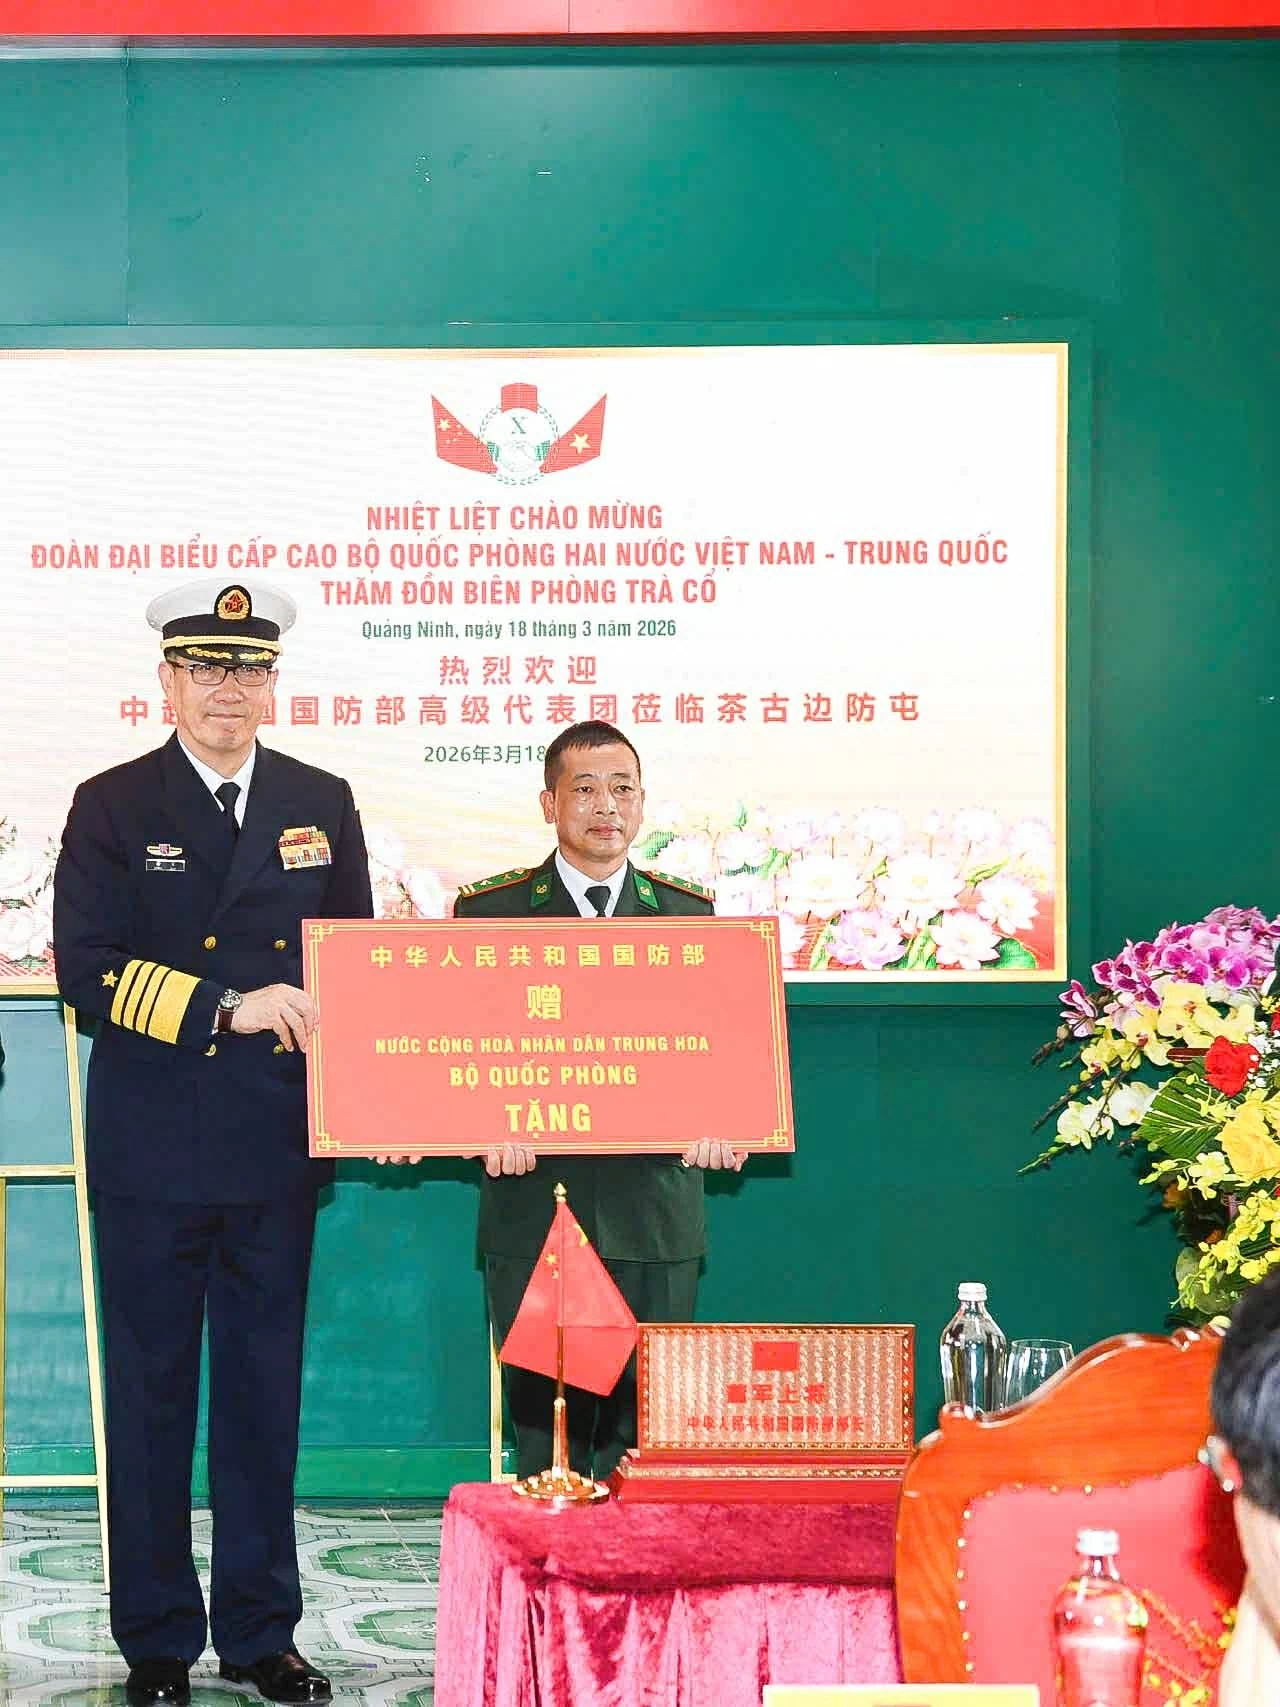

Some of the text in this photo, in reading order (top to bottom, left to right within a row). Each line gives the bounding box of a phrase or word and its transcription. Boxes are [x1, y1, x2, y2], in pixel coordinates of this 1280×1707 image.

[367, 499, 663, 536] NHIỆT LIỆT CHÀO MỪNG
[31, 538, 99, 569] ĐOÀN
[108, 544, 150, 576] ĐẠI
[160, 533, 218, 569] BIỂU
[228, 535, 277, 569] CẤP
[287, 544, 337, 569] CAO
[347, 538, 380, 576] BỘ
[390, 534, 459, 569] QUỐC
[469, 538, 555, 568] PHÒNG
[565, 543, 606, 567] HAI
[616, 536, 685, 567] NƯỚC
[695, 536, 749, 572] VIỆT
[759, 542, 815, 565] NAM
[845, 540, 928, 566] TRUNG
[938, 530, 1008, 567] QUỐC
[321, 574, 392, 606] THĂM
[463, 575, 521, 605] BIÊN
[531, 574, 617, 605] PHÒNG
[626, 574, 674, 604] TRÀ
[418, 621, 459, 639] Ninh,
[465, 621, 503, 640] ngày
[509, 621, 527, 637] 18
[533, 619, 577, 639] tháng
[582, 621, 592, 637] 3
[598, 619, 631, 637] năm
[637, 620, 677, 637] 2026
[440, 655, 597, 685] 热烈欢迎
[370, 943, 705, 968] 中华人民共和国国防部
[527, 984, 562, 1020] 赠
[375, 1034, 709, 1056] NƯỚC CỘNG HOÀ NHÂN DÂN TRUNG HOA
[449, 1059, 638, 1090] BỘ QUỐC PHÒNG
[504, 1098, 592, 1139] TẶNG
